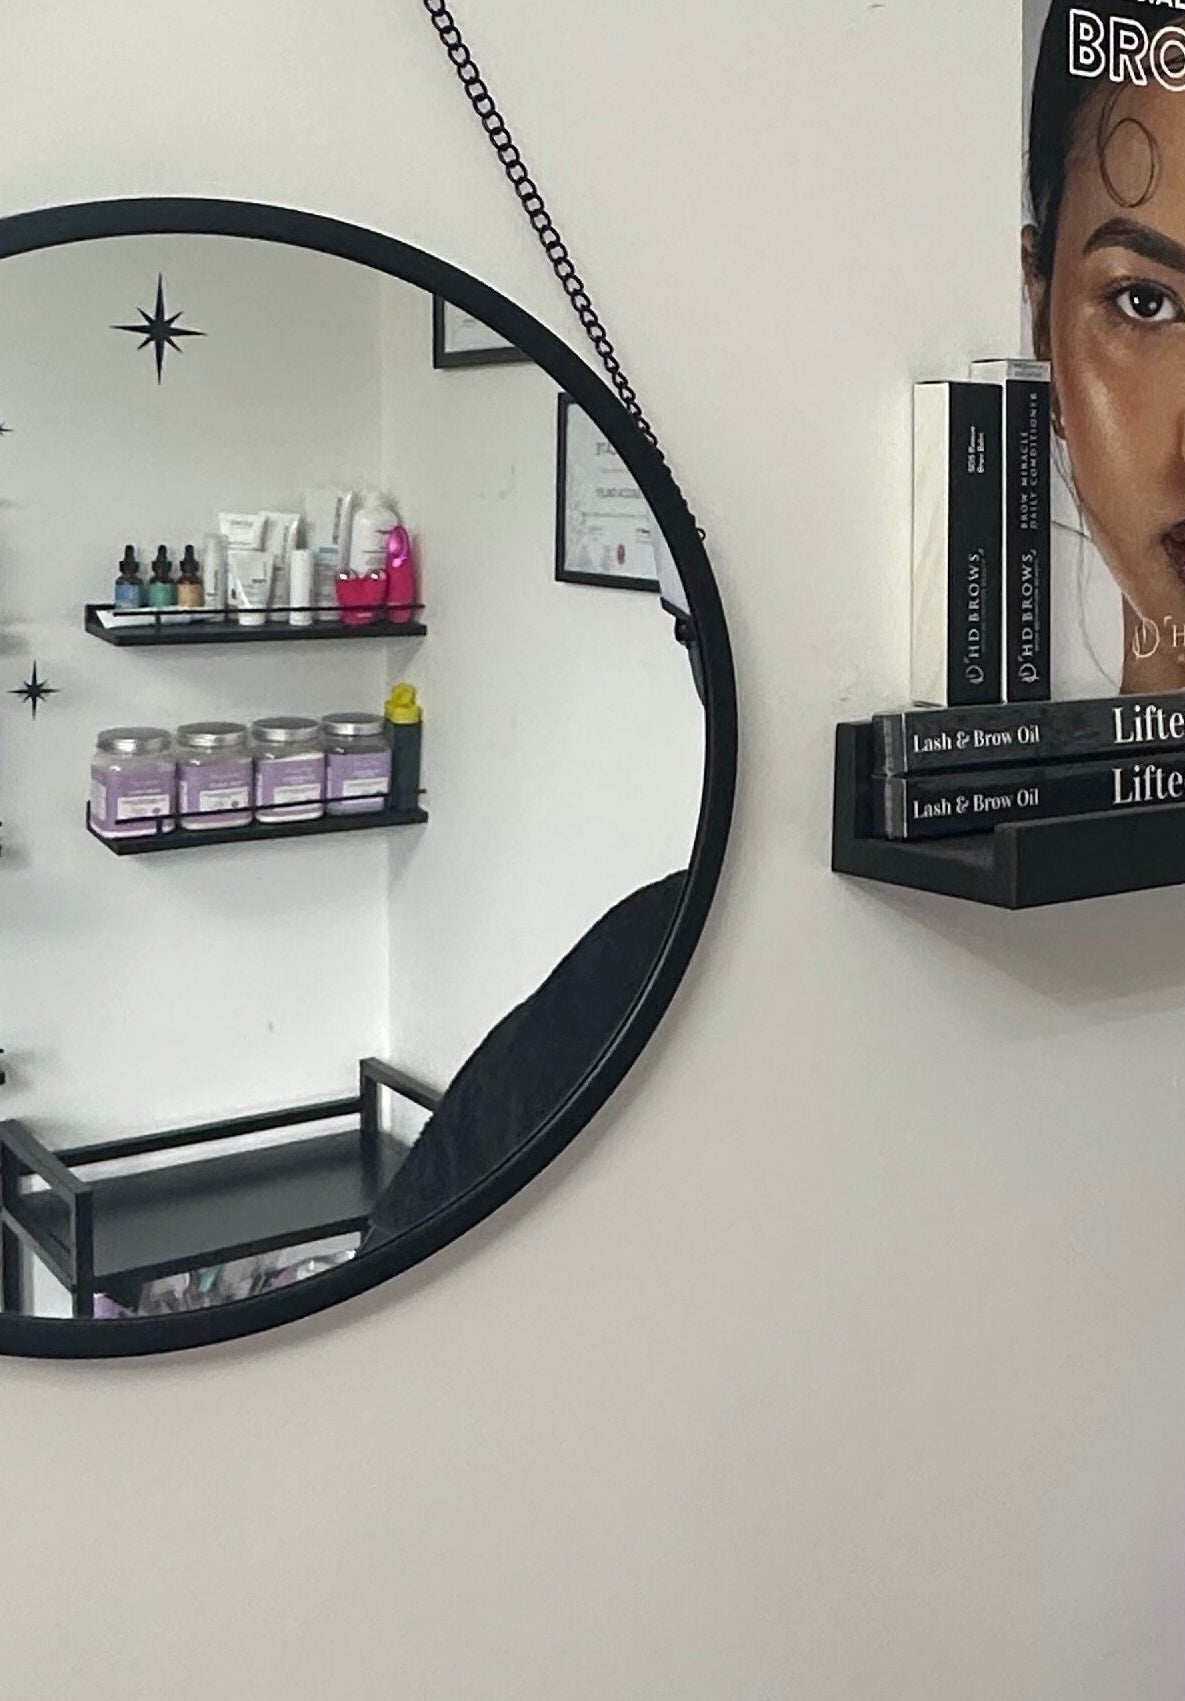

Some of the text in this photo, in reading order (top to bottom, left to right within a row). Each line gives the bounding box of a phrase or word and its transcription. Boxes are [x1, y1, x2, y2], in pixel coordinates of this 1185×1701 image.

[1020, 492, 1029, 530] BROW
[1029, 490, 1038, 530] DAILY
[967, 553, 980, 659] HD BROWS
[1021, 553, 1033, 657] HD BROWS
[913, 725, 1040, 753] Lash & Brow Oil
[913, 788, 1039, 819] Lash & Brow Oil
